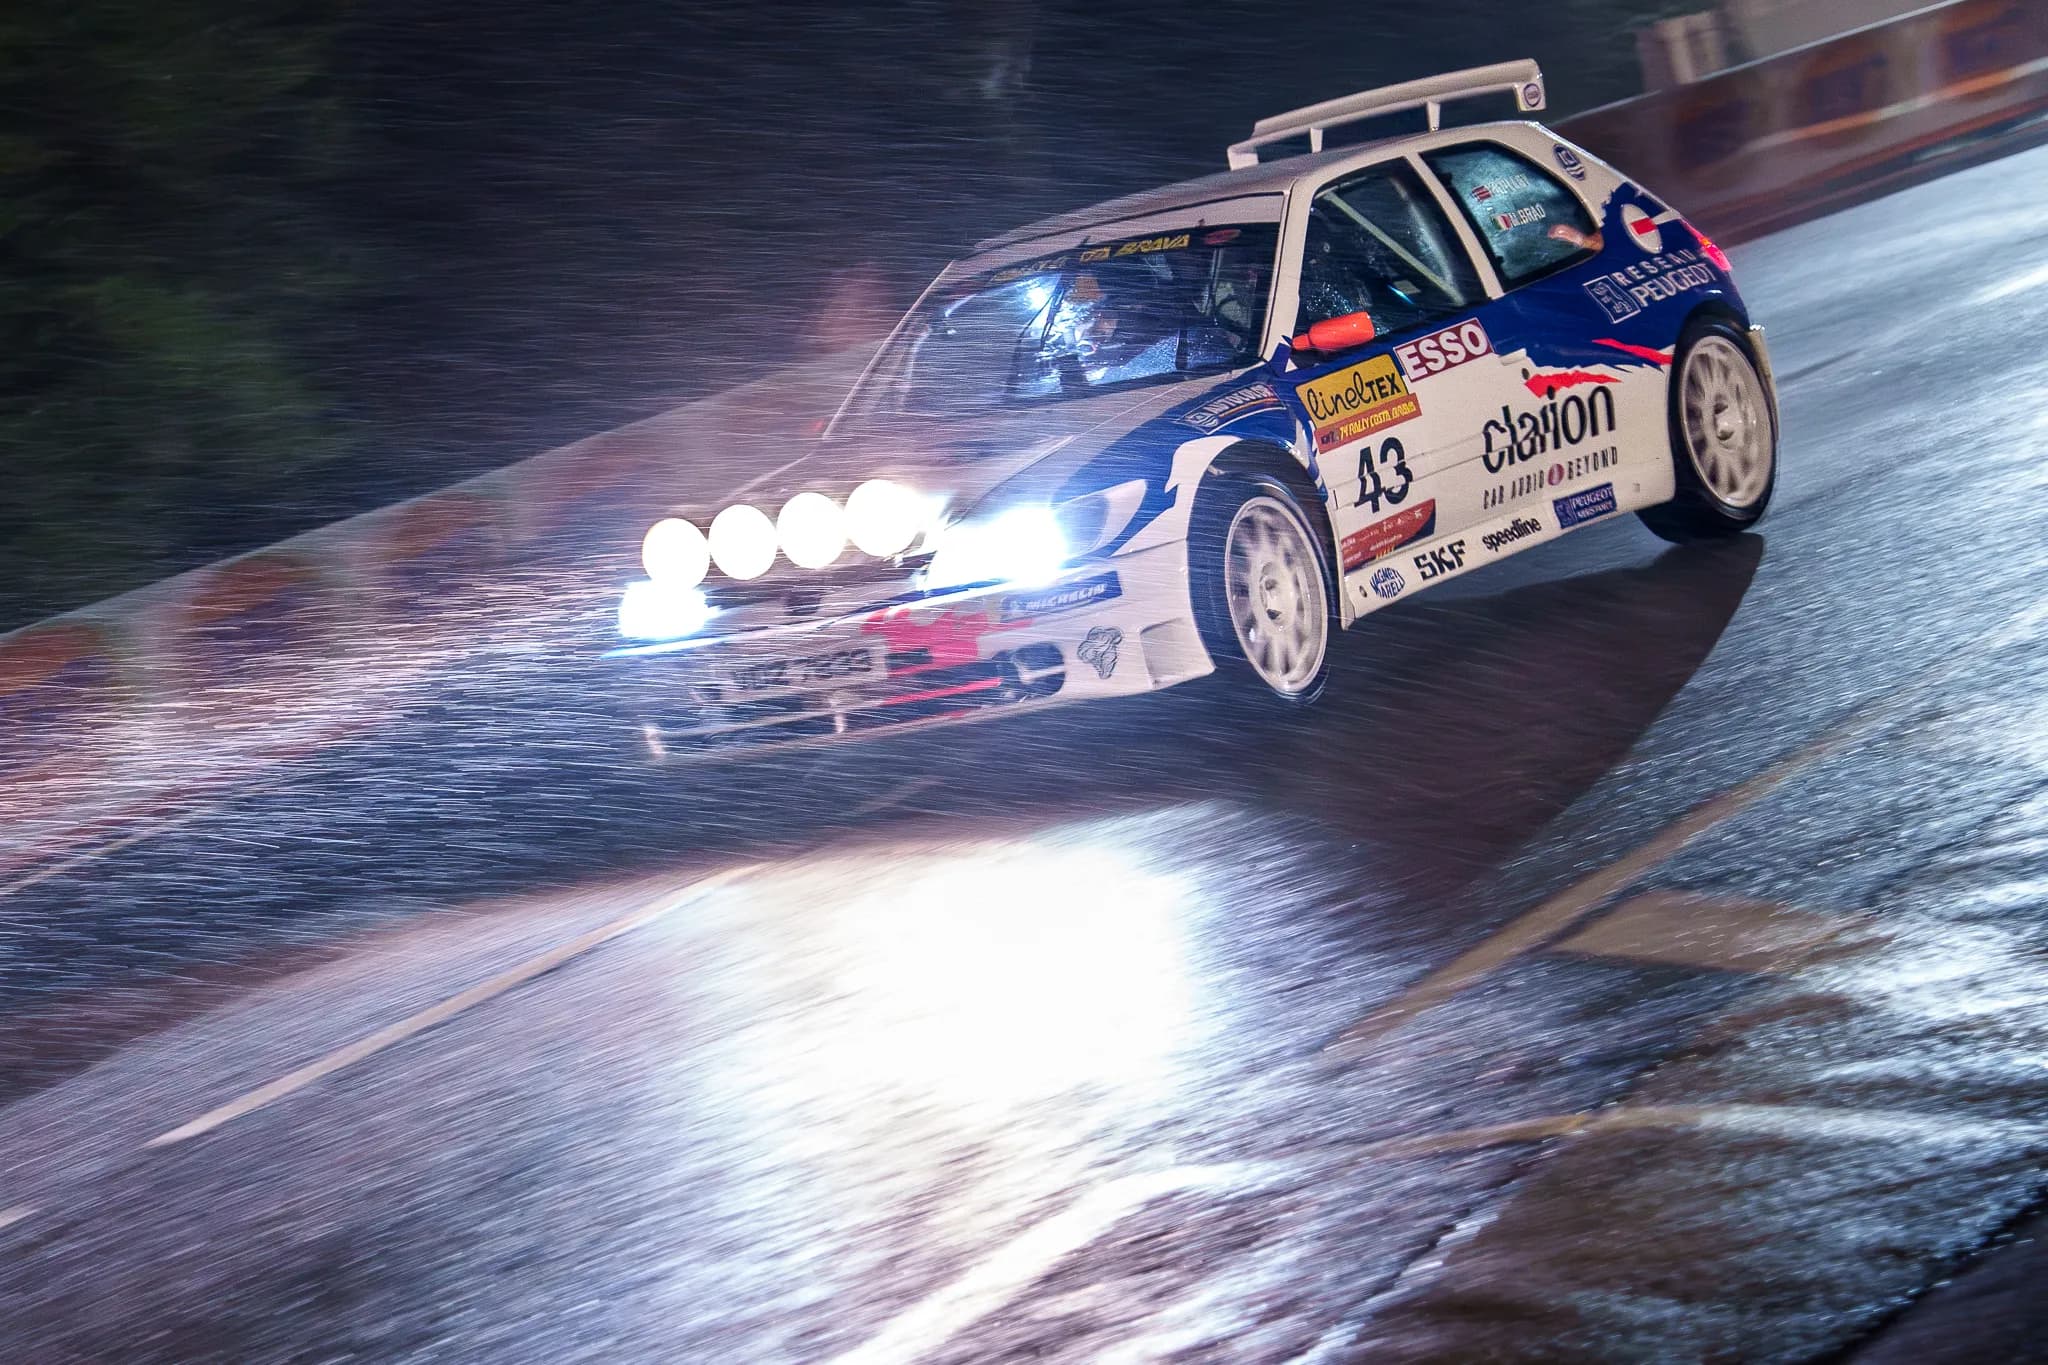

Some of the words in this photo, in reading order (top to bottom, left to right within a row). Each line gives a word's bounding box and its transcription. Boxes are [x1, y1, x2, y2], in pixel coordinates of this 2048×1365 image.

[1611, 249, 1697, 286] RESEAU
[1629, 263, 1717, 307] PEUGEOT
[1400, 323, 1489, 380] ESSO
[1482, 385, 1616, 475] clarion
[1354, 437, 1413, 514] 43
[1483, 485, 1505, 510] CAR
[1511, 470, 1545, 499] AUDIO
[1567, 446, 1618, 480] BEYOND
[1571, 487, 1614, 509] PEUGEOT
[1482, 517, 1542, 552] speedline
[1413, 539, 1466, 581] SKF
[1026, 583, 1108, 609] MICHELIN
